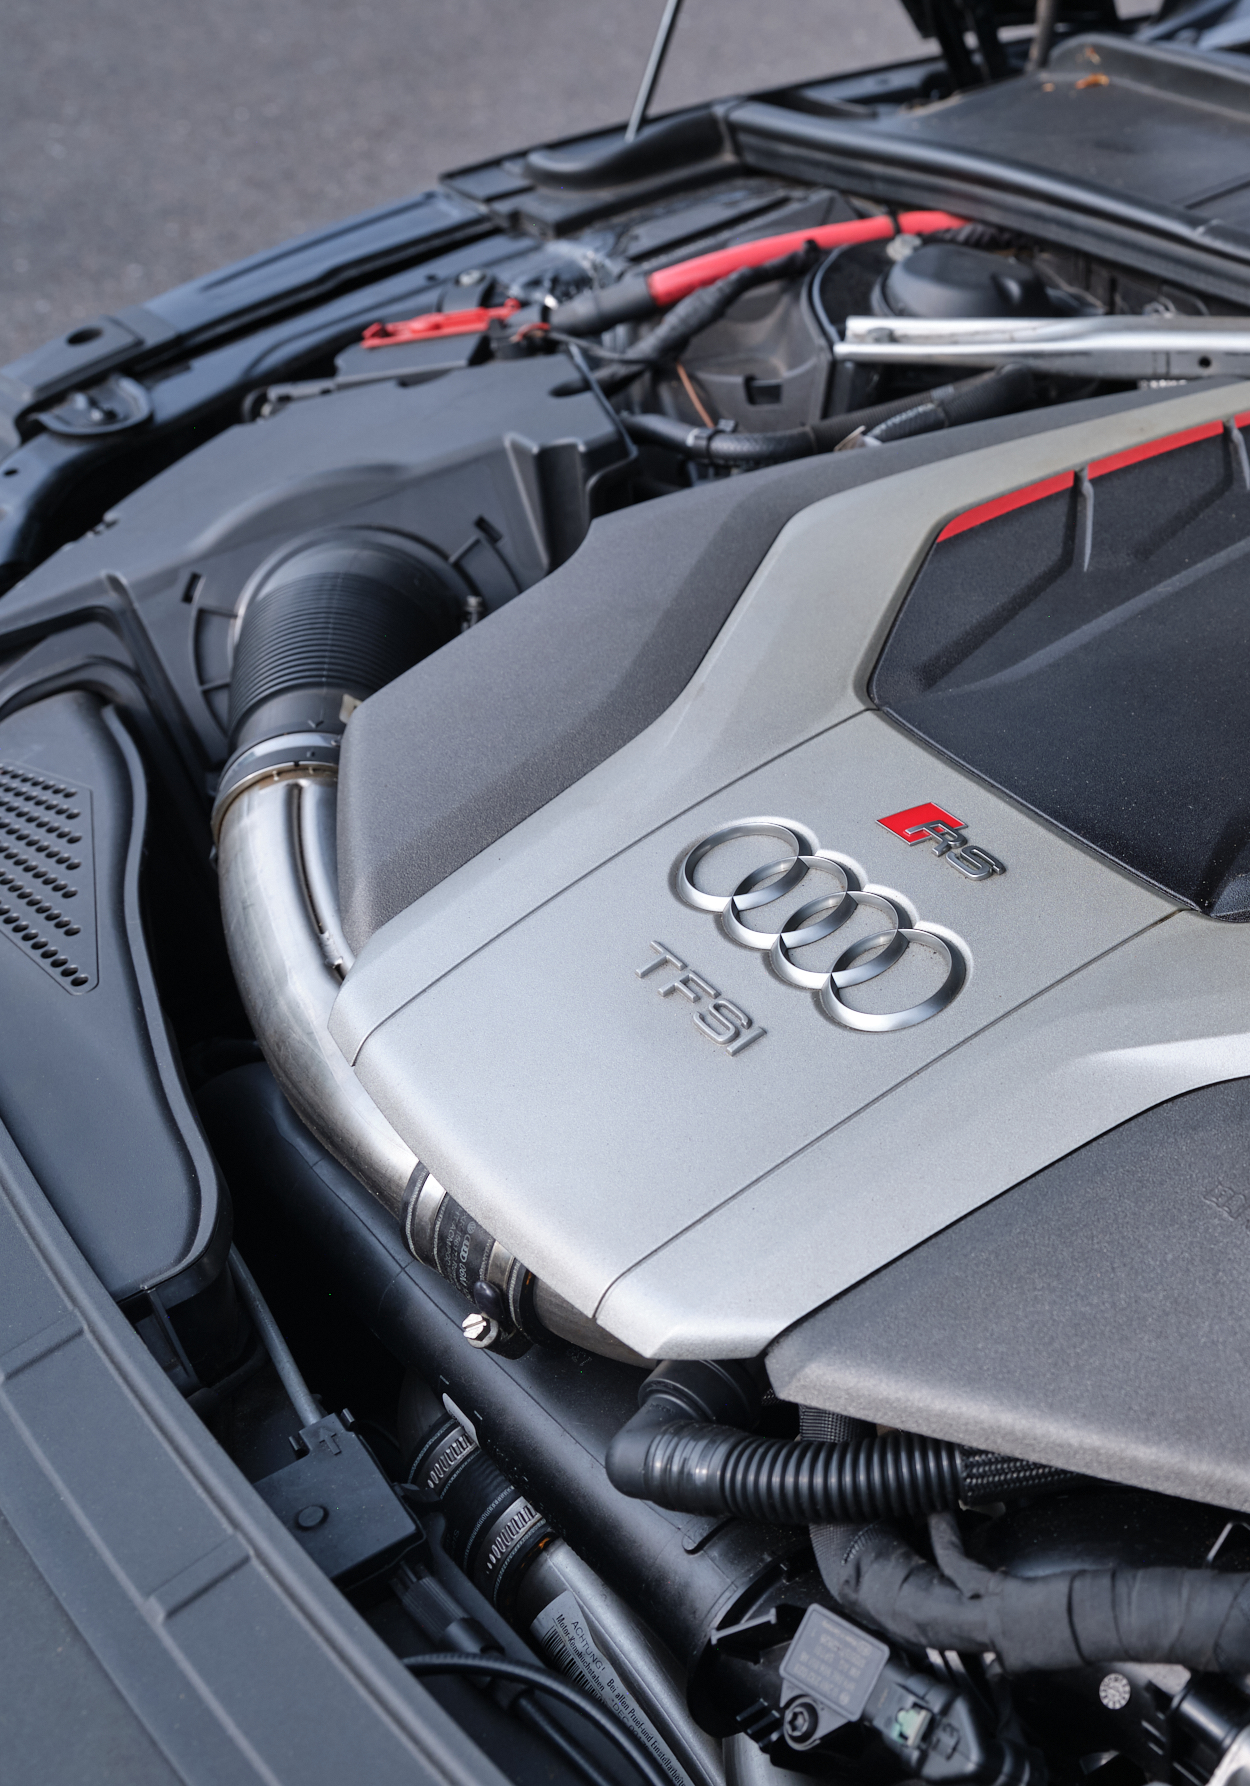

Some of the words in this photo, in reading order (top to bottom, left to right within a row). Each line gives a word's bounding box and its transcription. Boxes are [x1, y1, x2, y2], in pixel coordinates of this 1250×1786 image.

[903, 819, 1006, 881] RS
[635, 940, 767, 1057] TFSI
[556, 1613, 605, 1692] Motor-Kennbuchstaben
[571, 1620, 606, 1672] ACHTUNG!
[606, 1678, 616, 1694] Bei
[615, 1692, 630, 1711] allen
